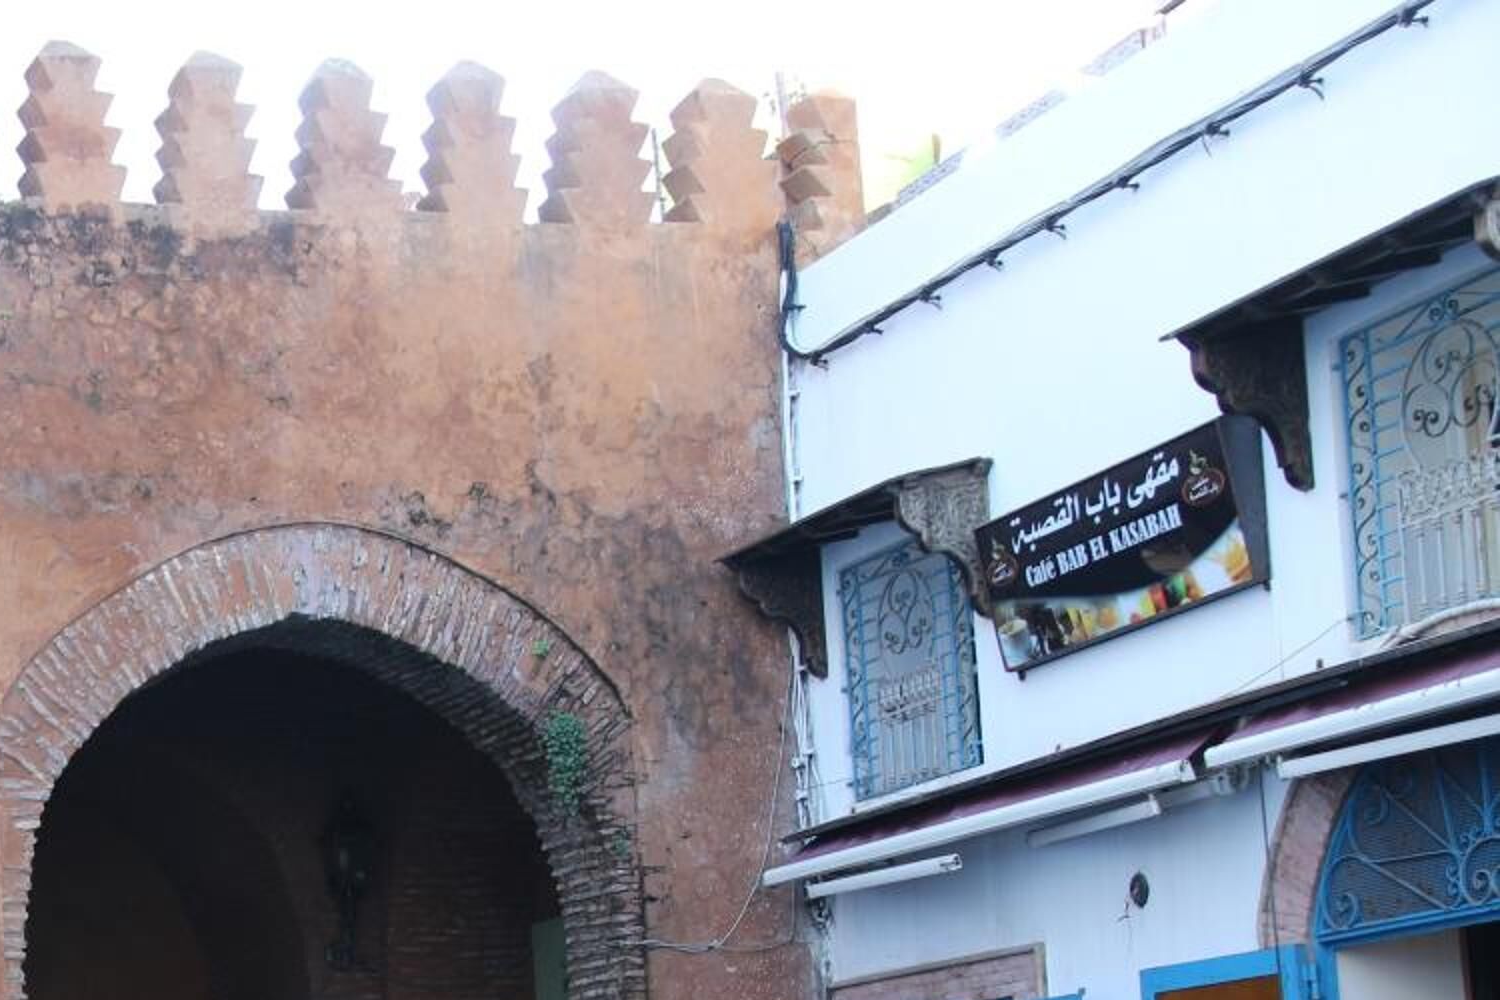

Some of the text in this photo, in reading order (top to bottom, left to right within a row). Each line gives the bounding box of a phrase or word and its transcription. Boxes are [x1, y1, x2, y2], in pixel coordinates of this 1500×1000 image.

[1086, 477, 1121, 524] باب
[1127, 452, 1179, 508] مقهى
[1010, 493, 1080, 554] القصبة
[1025, 554, 1057, 587] Café
[1056, 543, 1088, 575] BAB
[1089, 535, 1108, 561] EL
[1109, 503, 1183, 553] KASABAH
